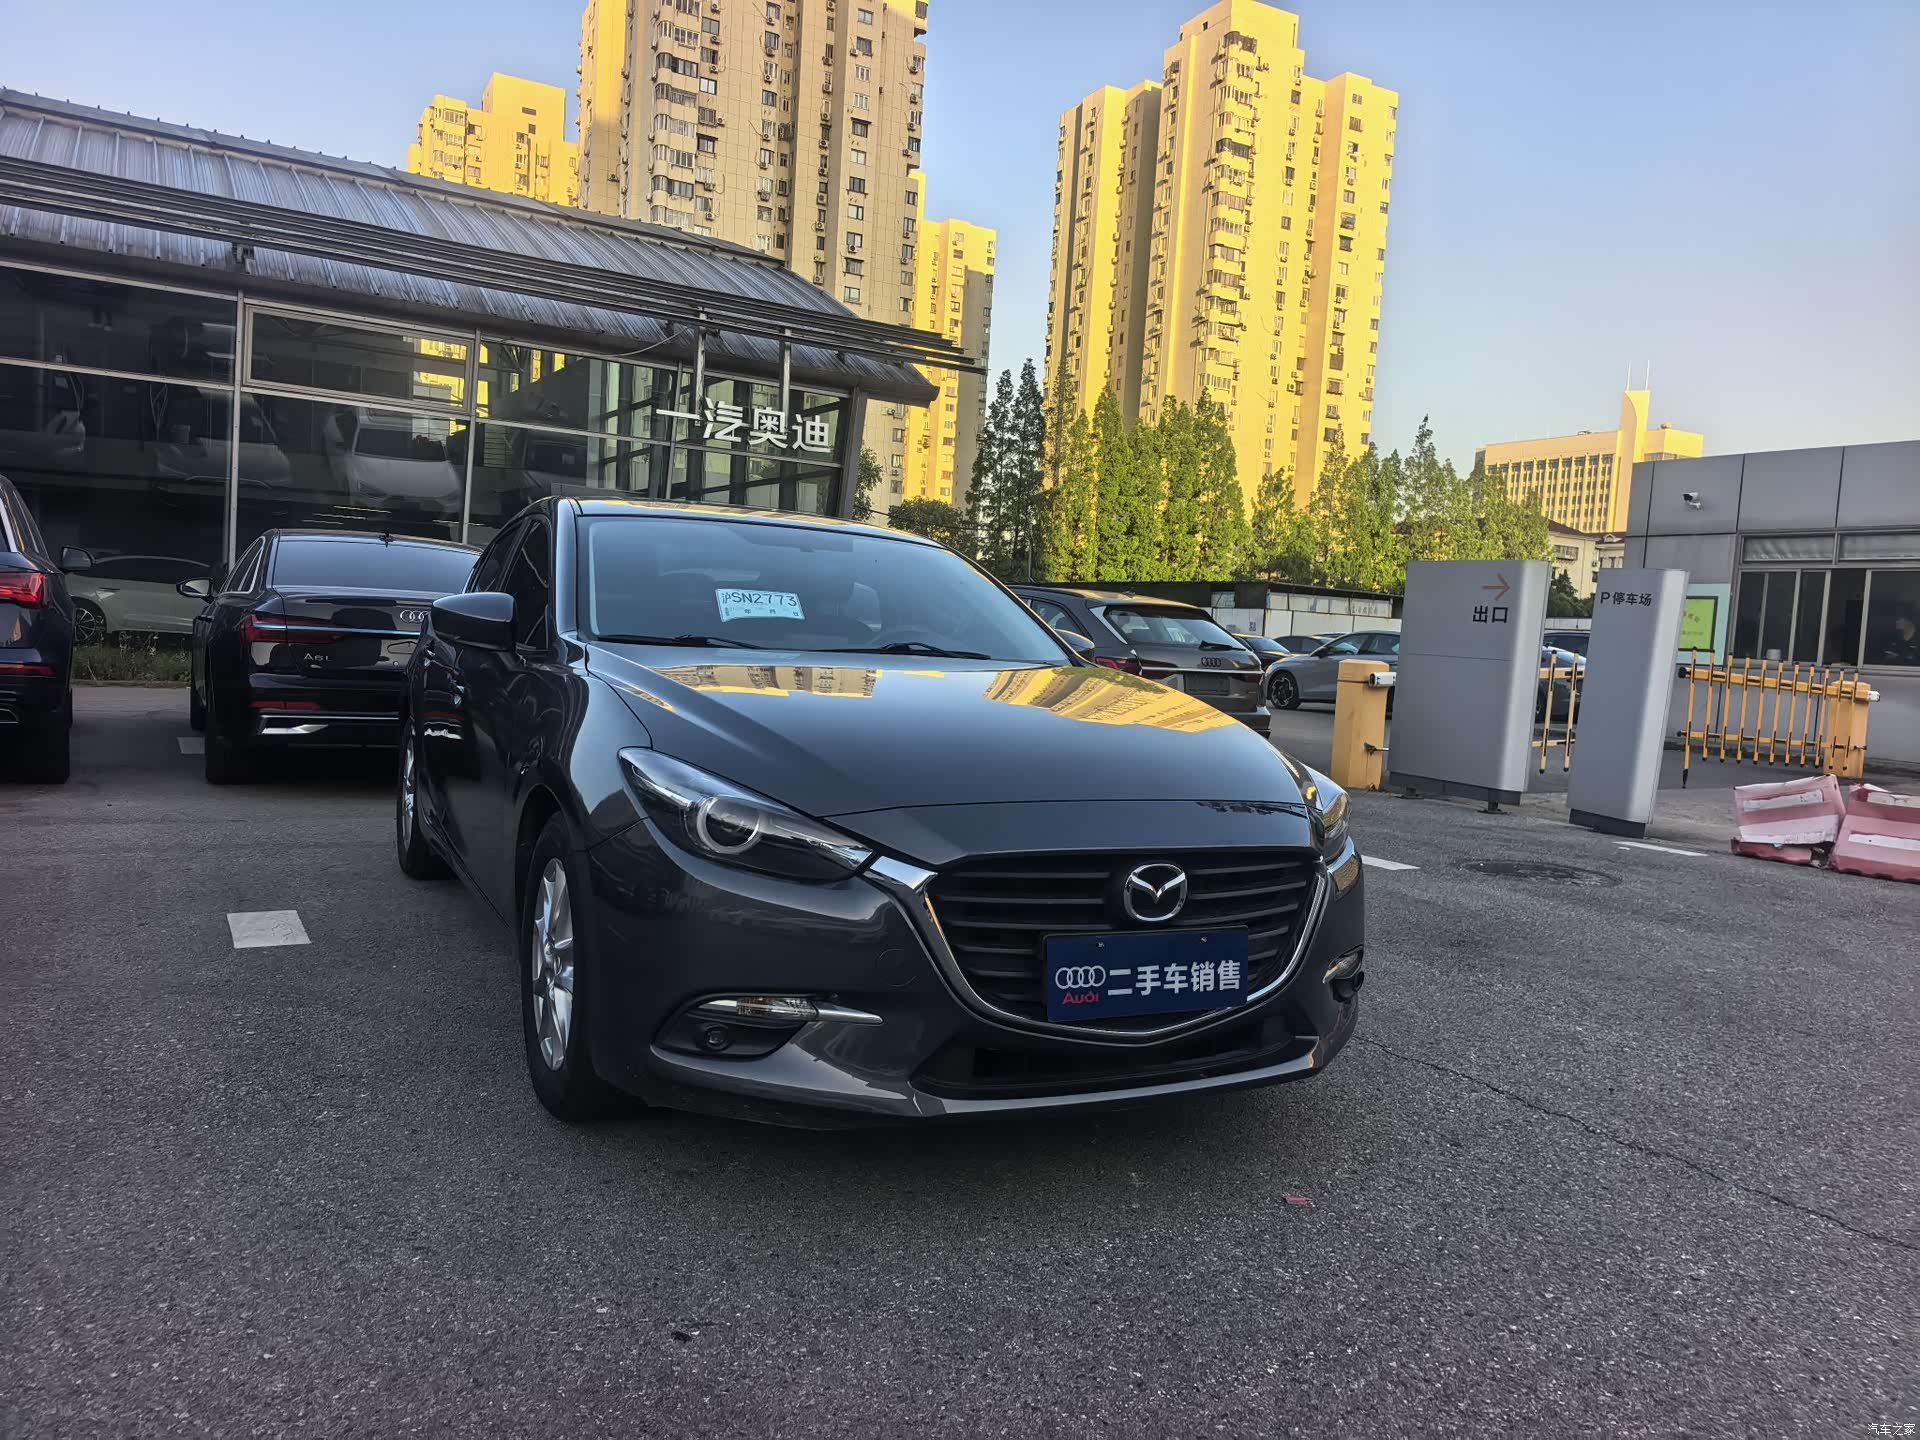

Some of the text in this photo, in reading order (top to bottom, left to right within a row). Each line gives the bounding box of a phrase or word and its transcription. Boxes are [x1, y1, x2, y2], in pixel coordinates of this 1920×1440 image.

[656, 397, 831, 452] 一汽奥迪
[1612, 591, 1652, 607] 停车场
[1472, 605, 1509, 624] 出口
[1107, 960, 1241, 996] 二手车销售
[1062, 991, 1100, 1005] Audi
